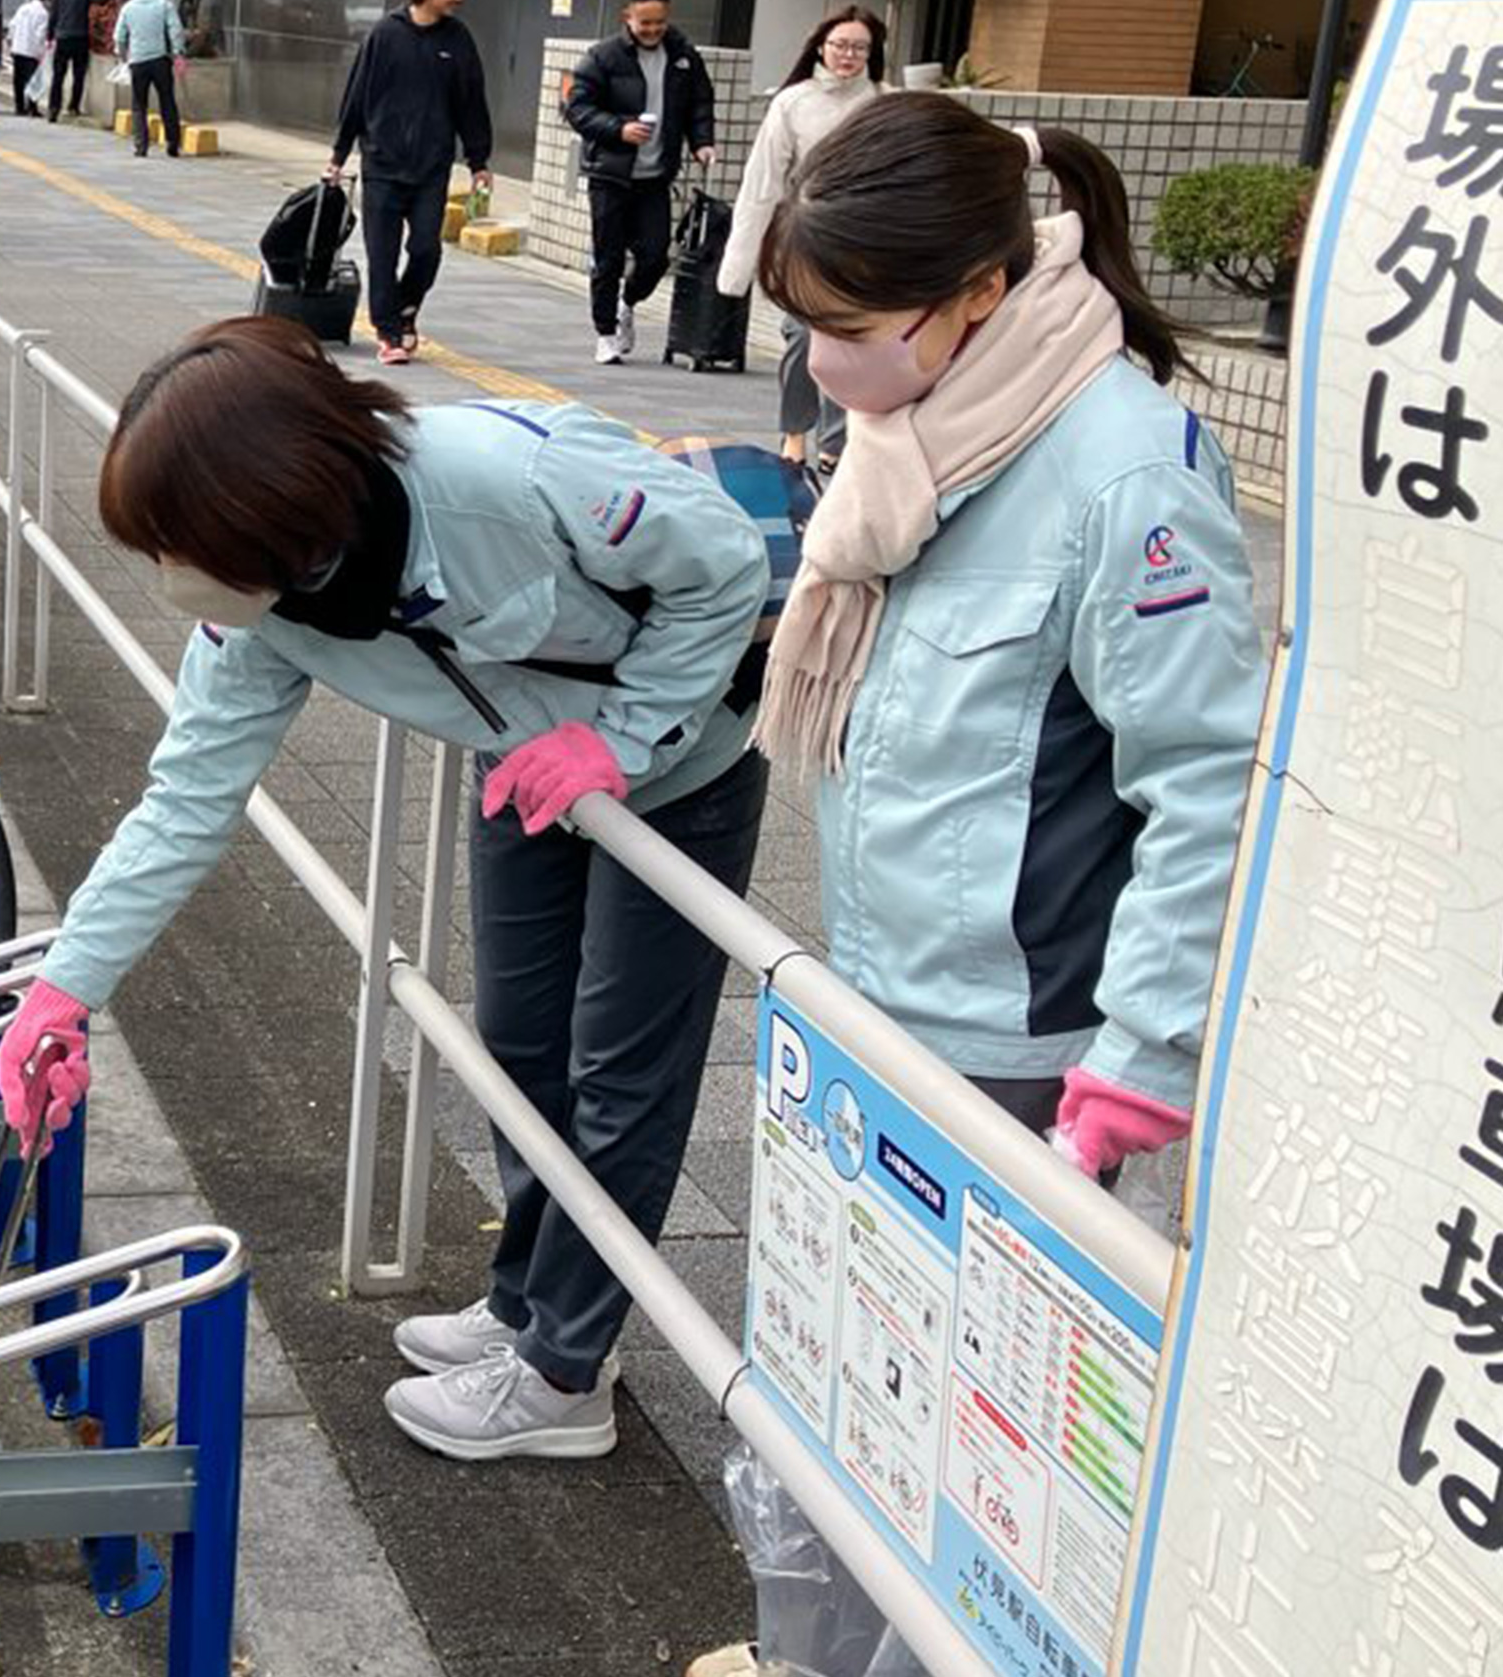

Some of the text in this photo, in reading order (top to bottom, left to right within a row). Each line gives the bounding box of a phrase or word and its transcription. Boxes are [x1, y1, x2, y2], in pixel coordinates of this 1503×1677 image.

[768, 1010, 812, 1121] P
[973, 1553, 1089, 1677] 伏見駅自転車
